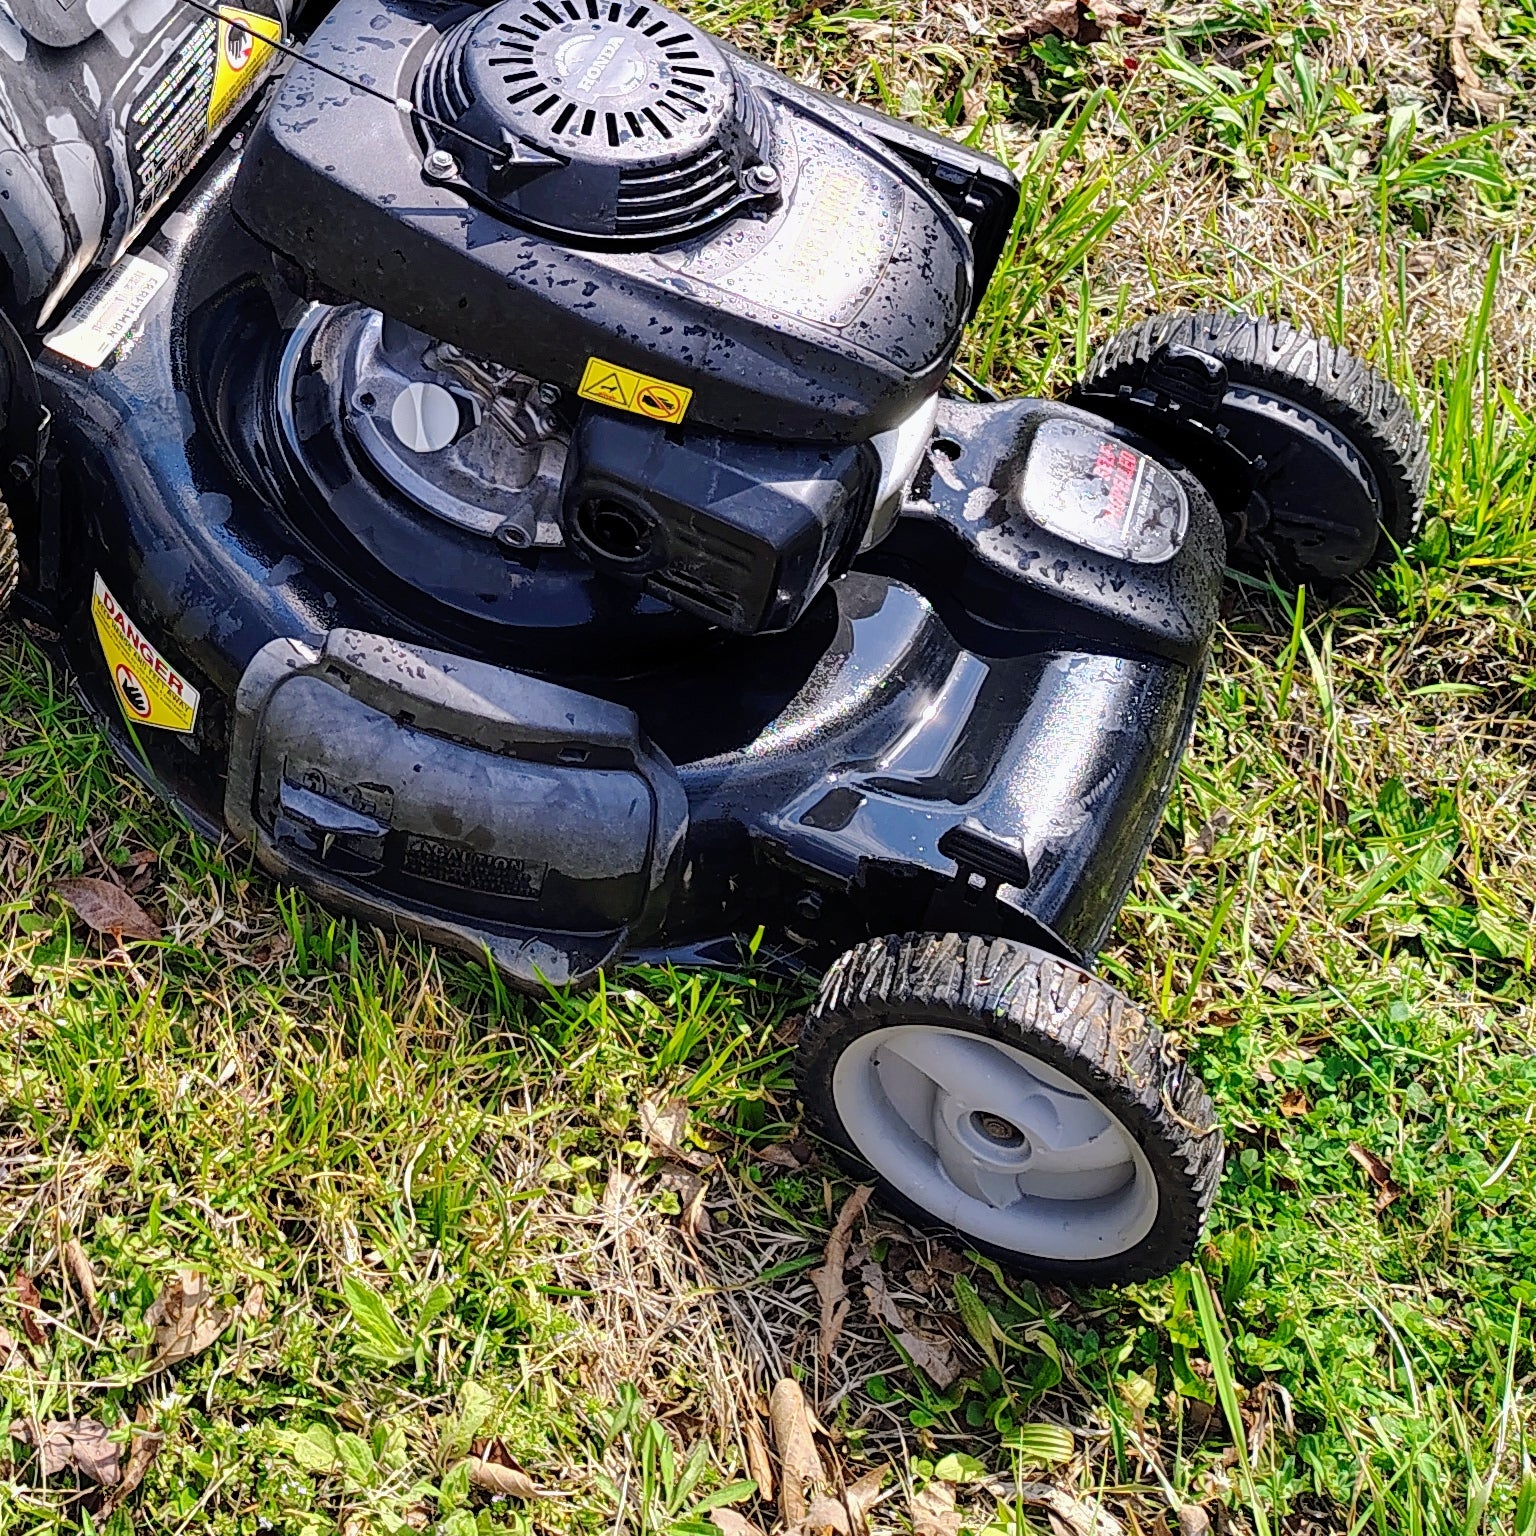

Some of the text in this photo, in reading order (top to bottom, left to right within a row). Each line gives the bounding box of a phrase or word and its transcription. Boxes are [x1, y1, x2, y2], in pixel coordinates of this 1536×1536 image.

[576, 36, 626, 93] HONDA
[103, 591, 184, 697] DANGER
[433, 845, 524, 872] CAUTION
